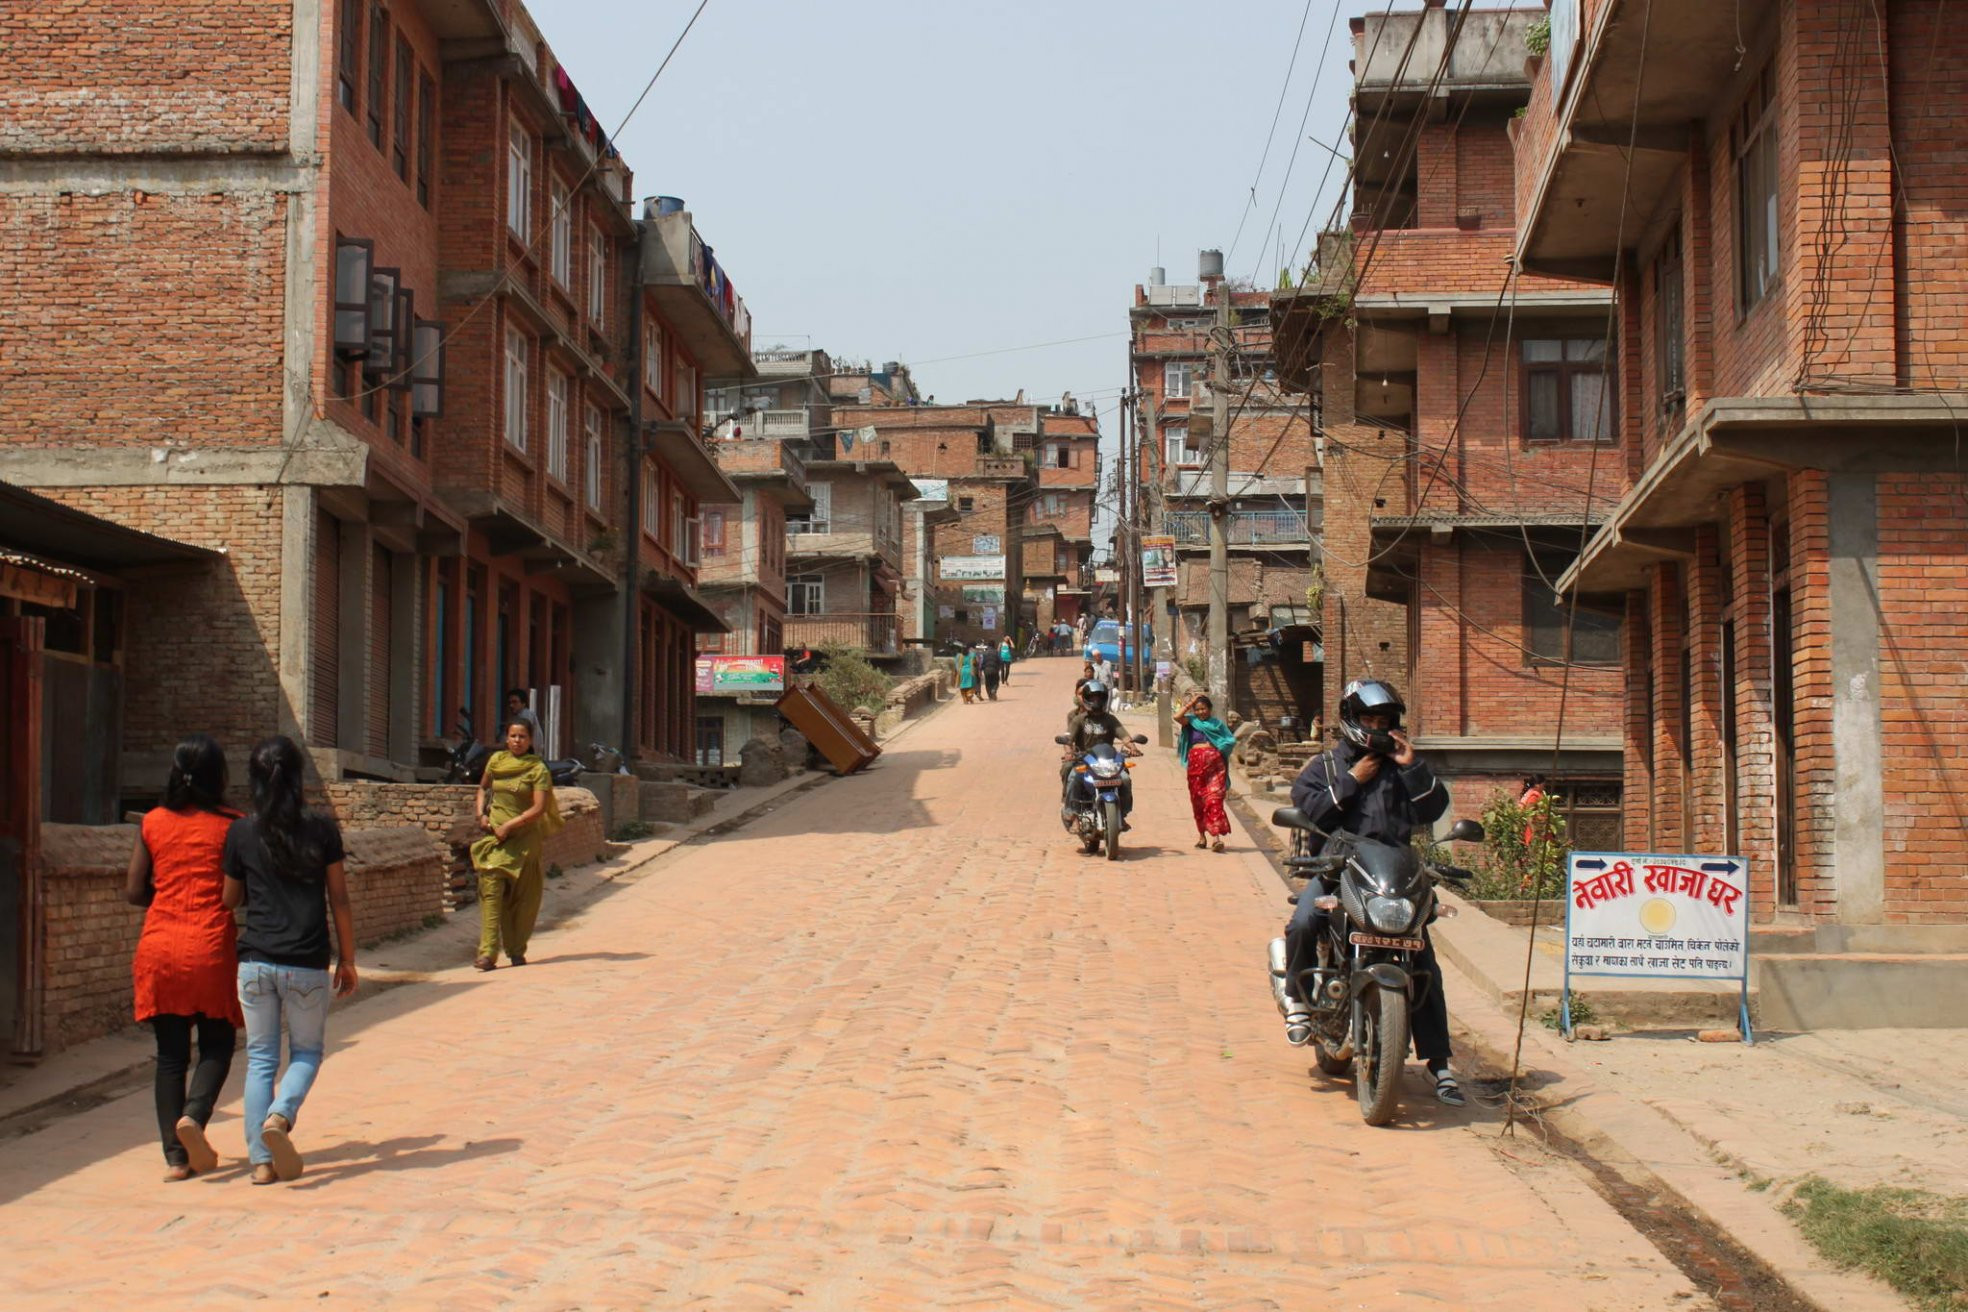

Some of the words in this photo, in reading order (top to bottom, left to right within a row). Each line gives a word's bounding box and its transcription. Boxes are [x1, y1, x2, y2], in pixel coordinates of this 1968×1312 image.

[1642, 864, 1709, 900] खाजा
[1706, 877, 1743, 916] घर
[1595, 955, 1601, 966] र
